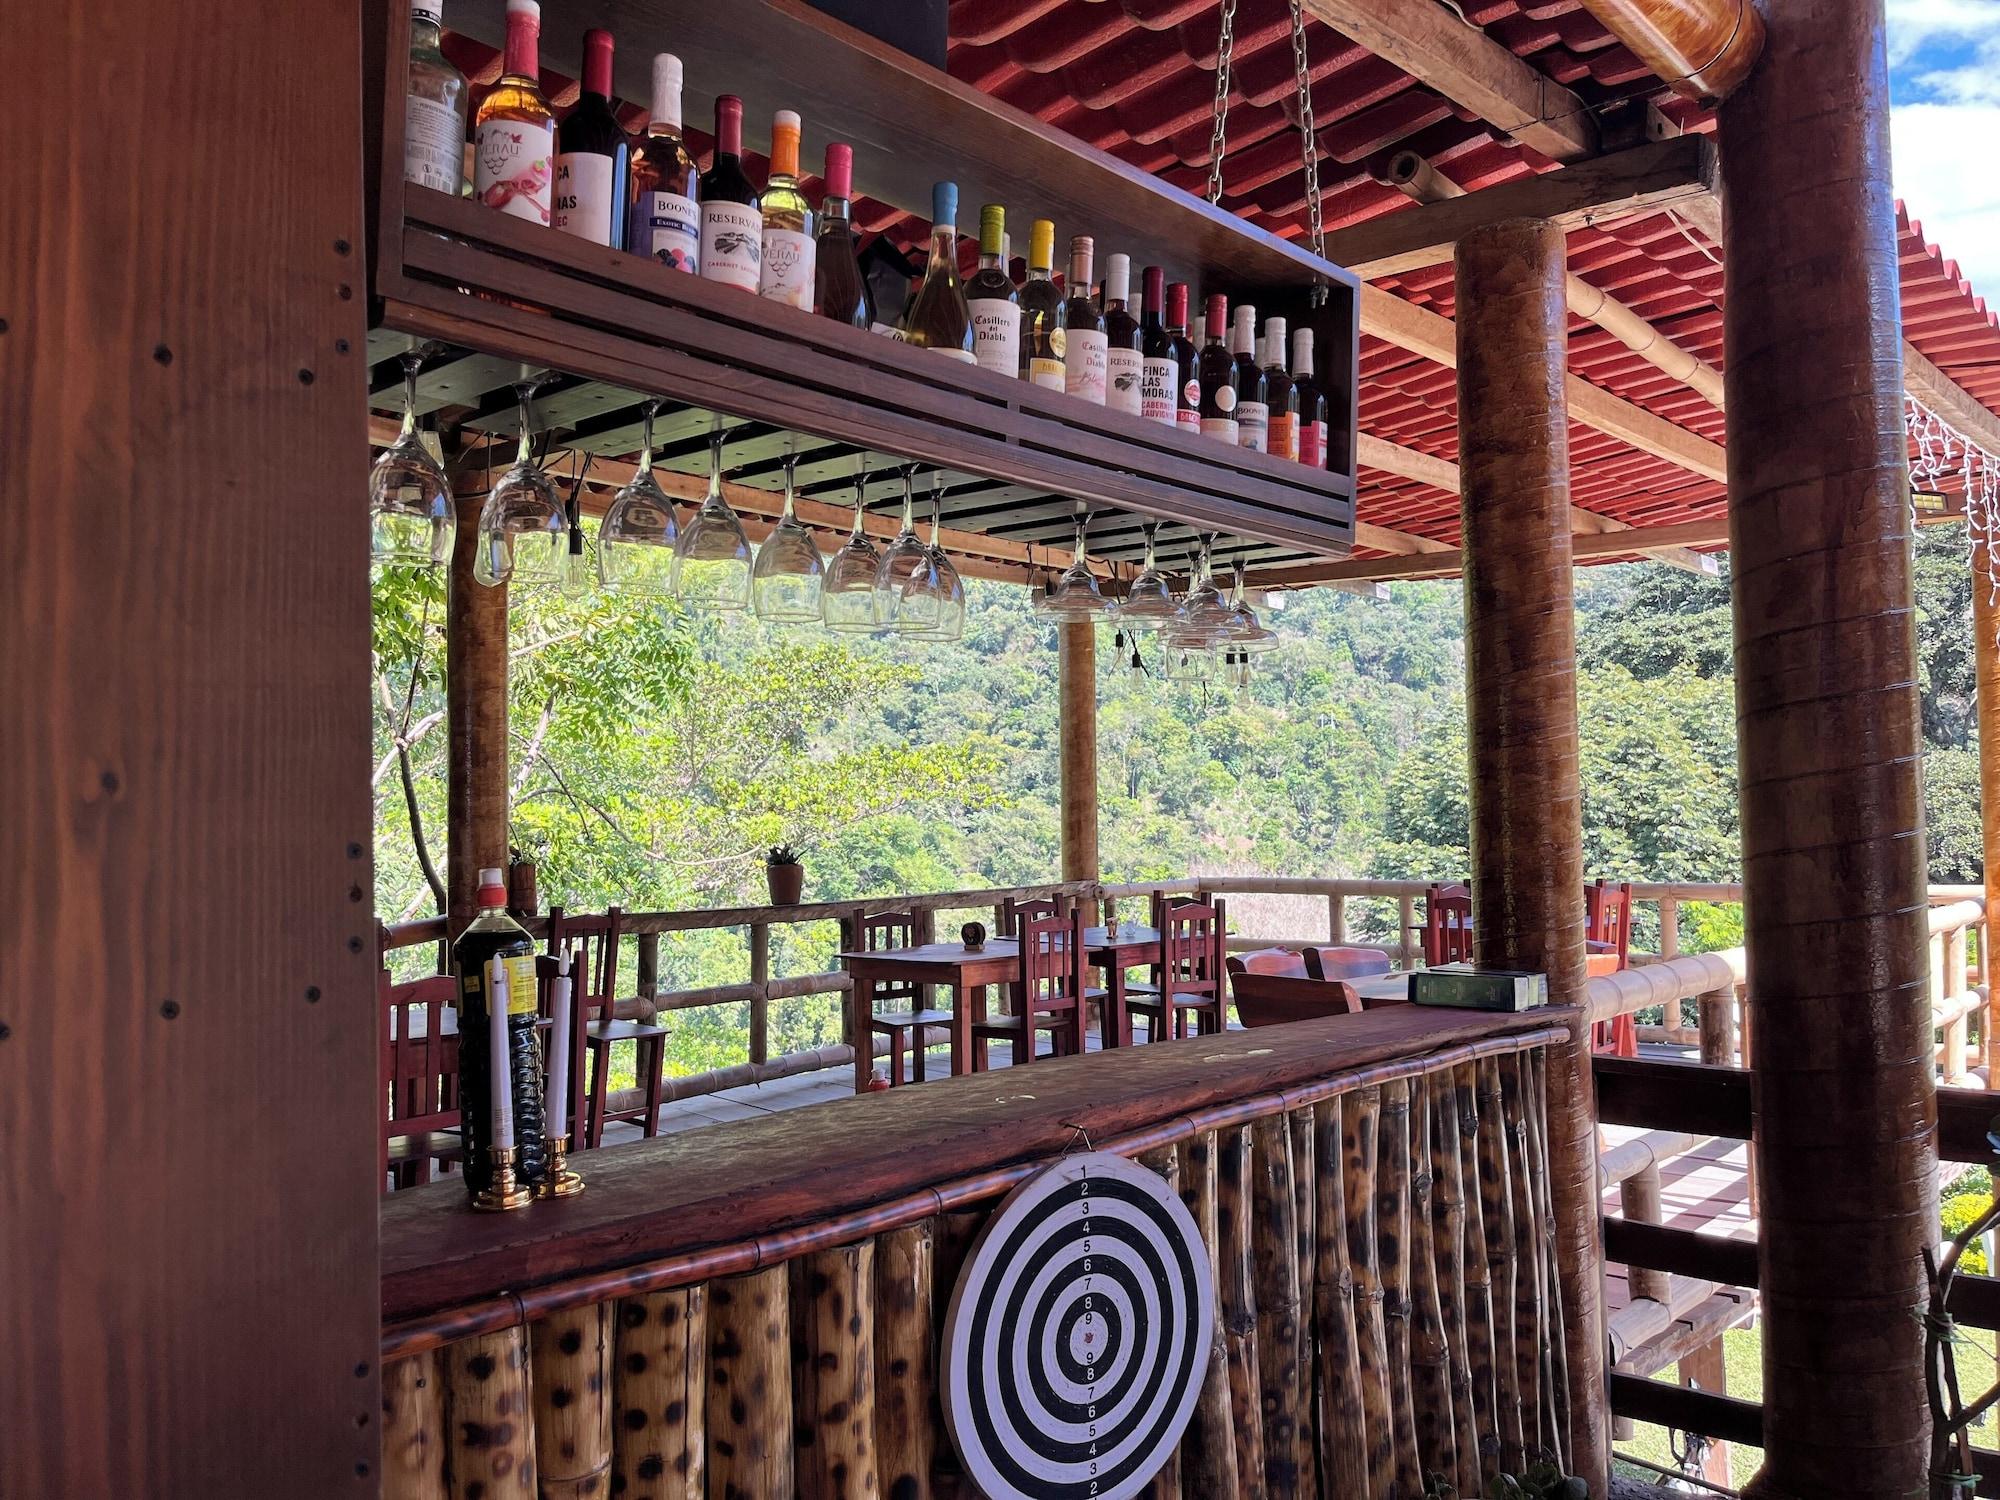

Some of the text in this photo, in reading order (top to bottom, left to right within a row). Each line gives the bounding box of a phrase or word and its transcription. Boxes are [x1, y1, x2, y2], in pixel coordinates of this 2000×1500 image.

[1142, 366, 1170, 378] FINCA
[1142, 377, 1161, 388] LAS
[1142, 388, 1174, 401] MORAS
[1081, 1165, 1086, 1178] 1
[1081, 1183, 1089, 1196] 2
[1082, 1202, 1089, 1215] 3
[1082, 1221, 1090, 1233] 4
[1083, 1240, 1091, 1252] 5
[1083, 1259, 1092, 1272] 6
[1084, 1278, 1092, 1290] 7
[1085, 1297, 1092, 1309] 8
[1086, 1312, 1092, 1325] 9
[1086, 1352, 1094, 1364] 9
[1086, 1368, 1095, 1381] 8
[1088, 1387, 1095, 1399] 7
[1088, 1405, 1096, 1418] 6
[1089, 1424, 1096, 1437] 5
[1089, 1443, 1097, 1456] 4
[1090, 1462, 1097, 1475] 3
[1090, 1481, 1098, 1494] 2
